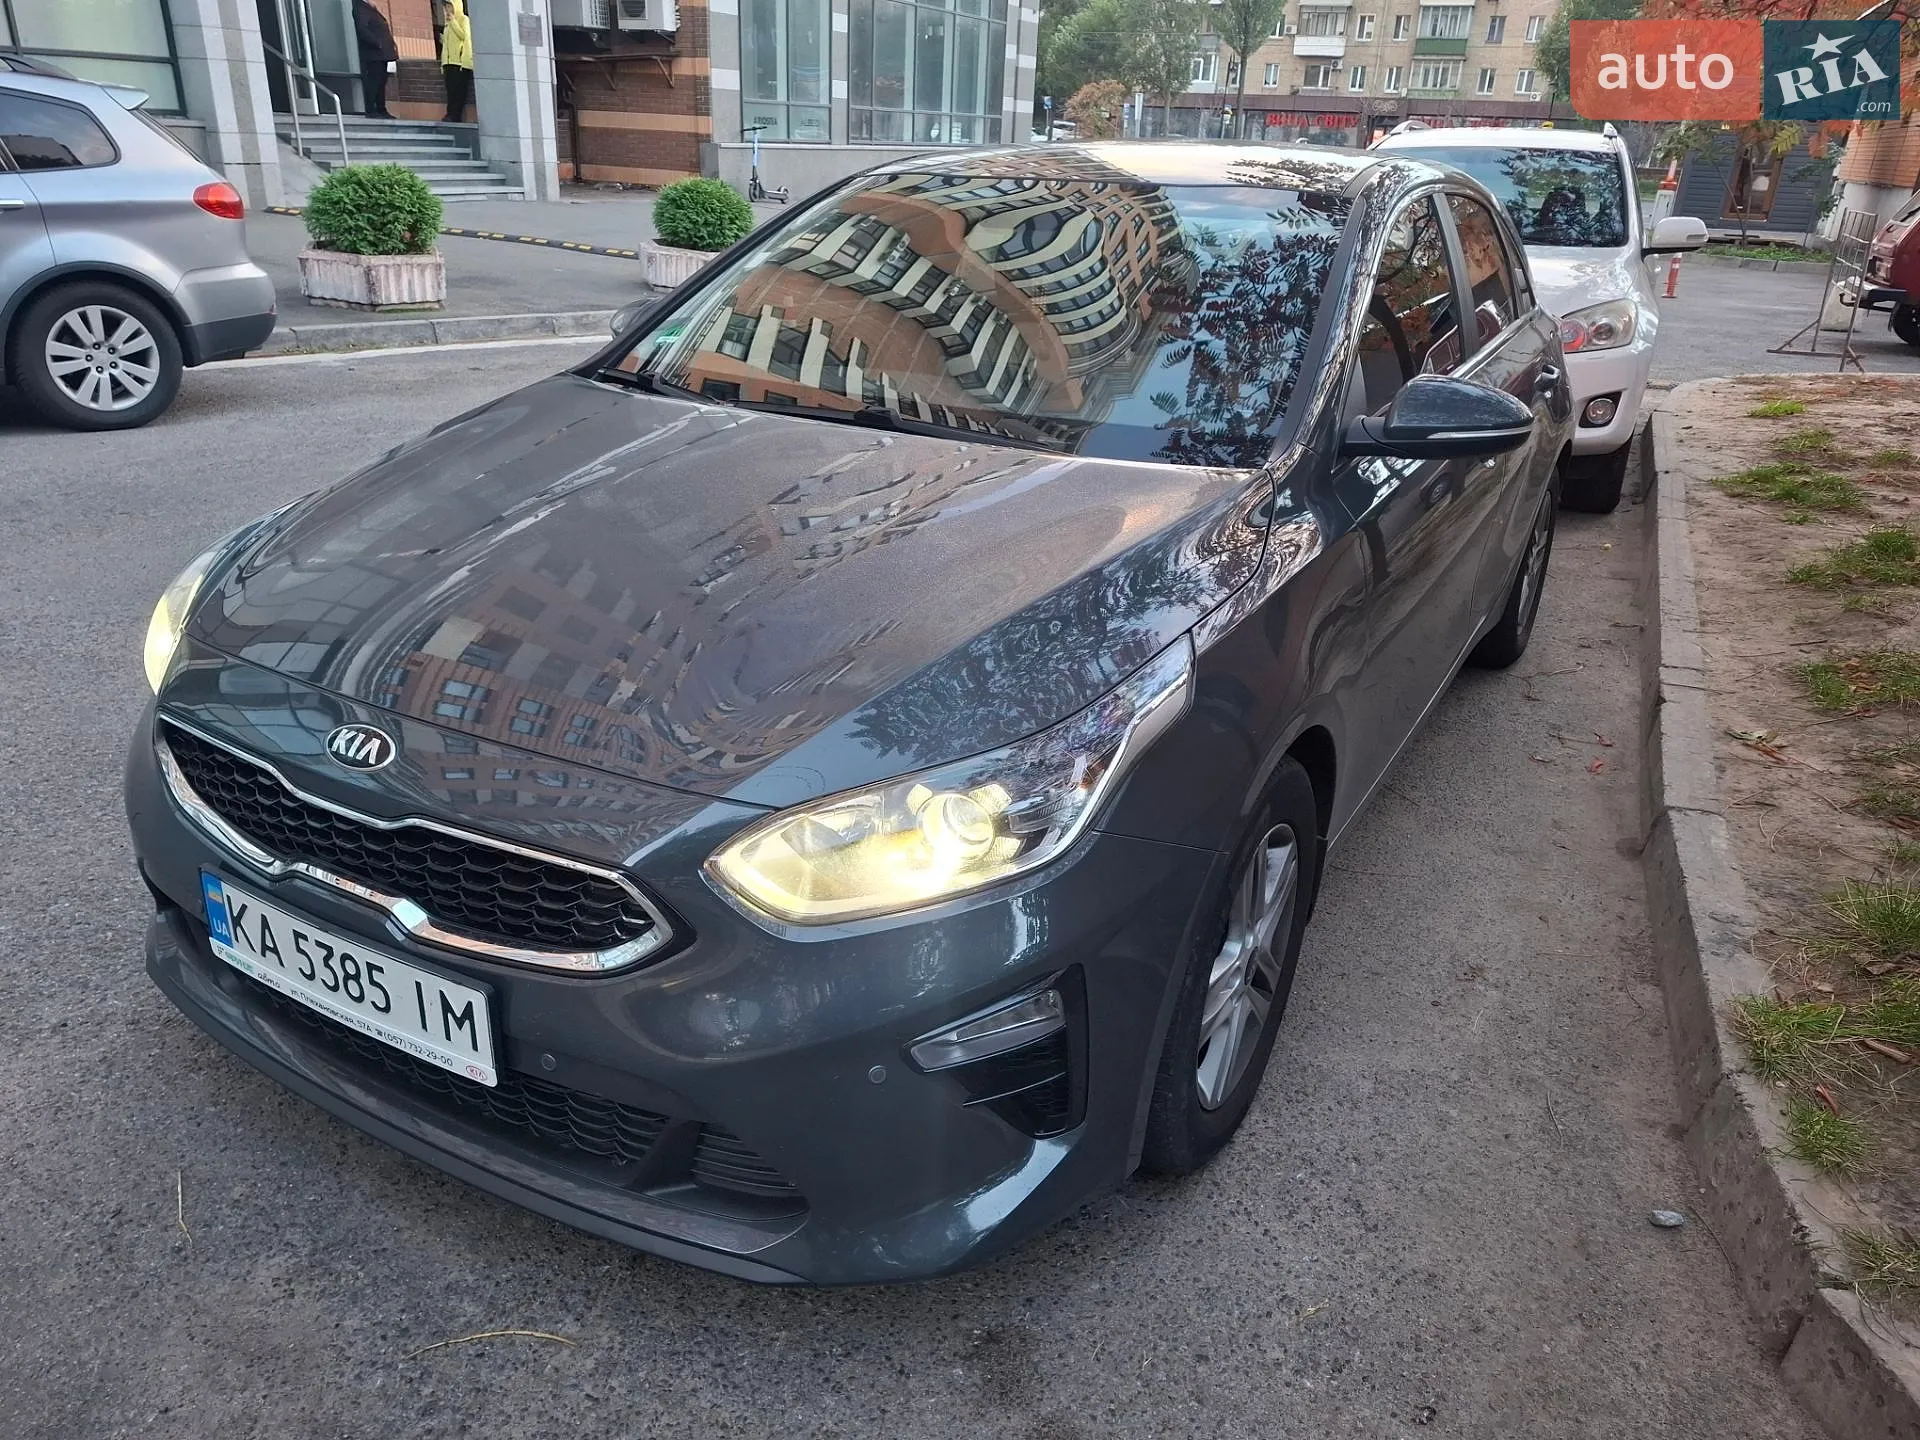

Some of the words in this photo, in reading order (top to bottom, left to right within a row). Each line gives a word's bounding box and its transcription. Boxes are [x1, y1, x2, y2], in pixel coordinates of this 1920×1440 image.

[331, 728, 381, 765] KIA
[213, 917, 231, 938] UA
[226, 894, 285, 968] KA
[292, 929, 391, 1015] 5385
[415, 980, 479, 1052] IM
[408, 1041, 453, 1067] 732-29-00
